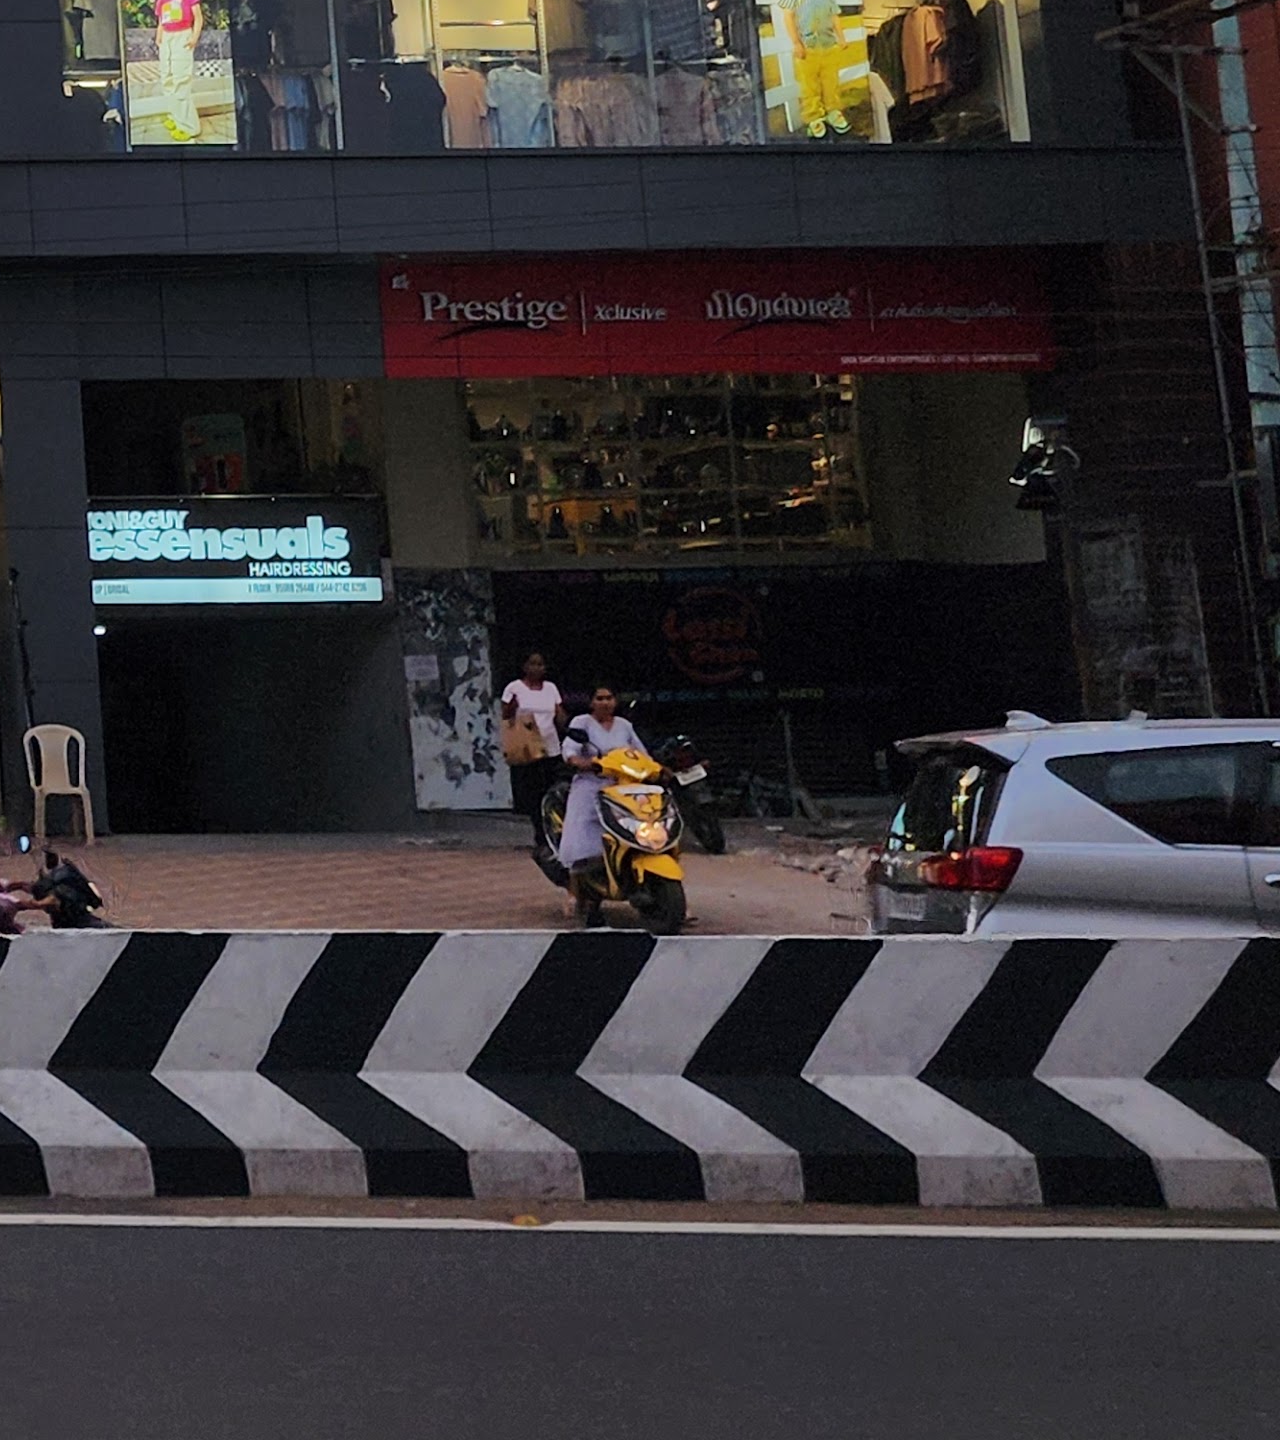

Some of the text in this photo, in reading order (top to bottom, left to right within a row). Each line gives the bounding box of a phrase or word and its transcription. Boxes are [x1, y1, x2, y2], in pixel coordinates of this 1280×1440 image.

[420, 291, 667, 329] Prestige Xclusive
[88, 515, 350, 562] essensuals
[248, 561, 352, 577] HAIRDRESSING
